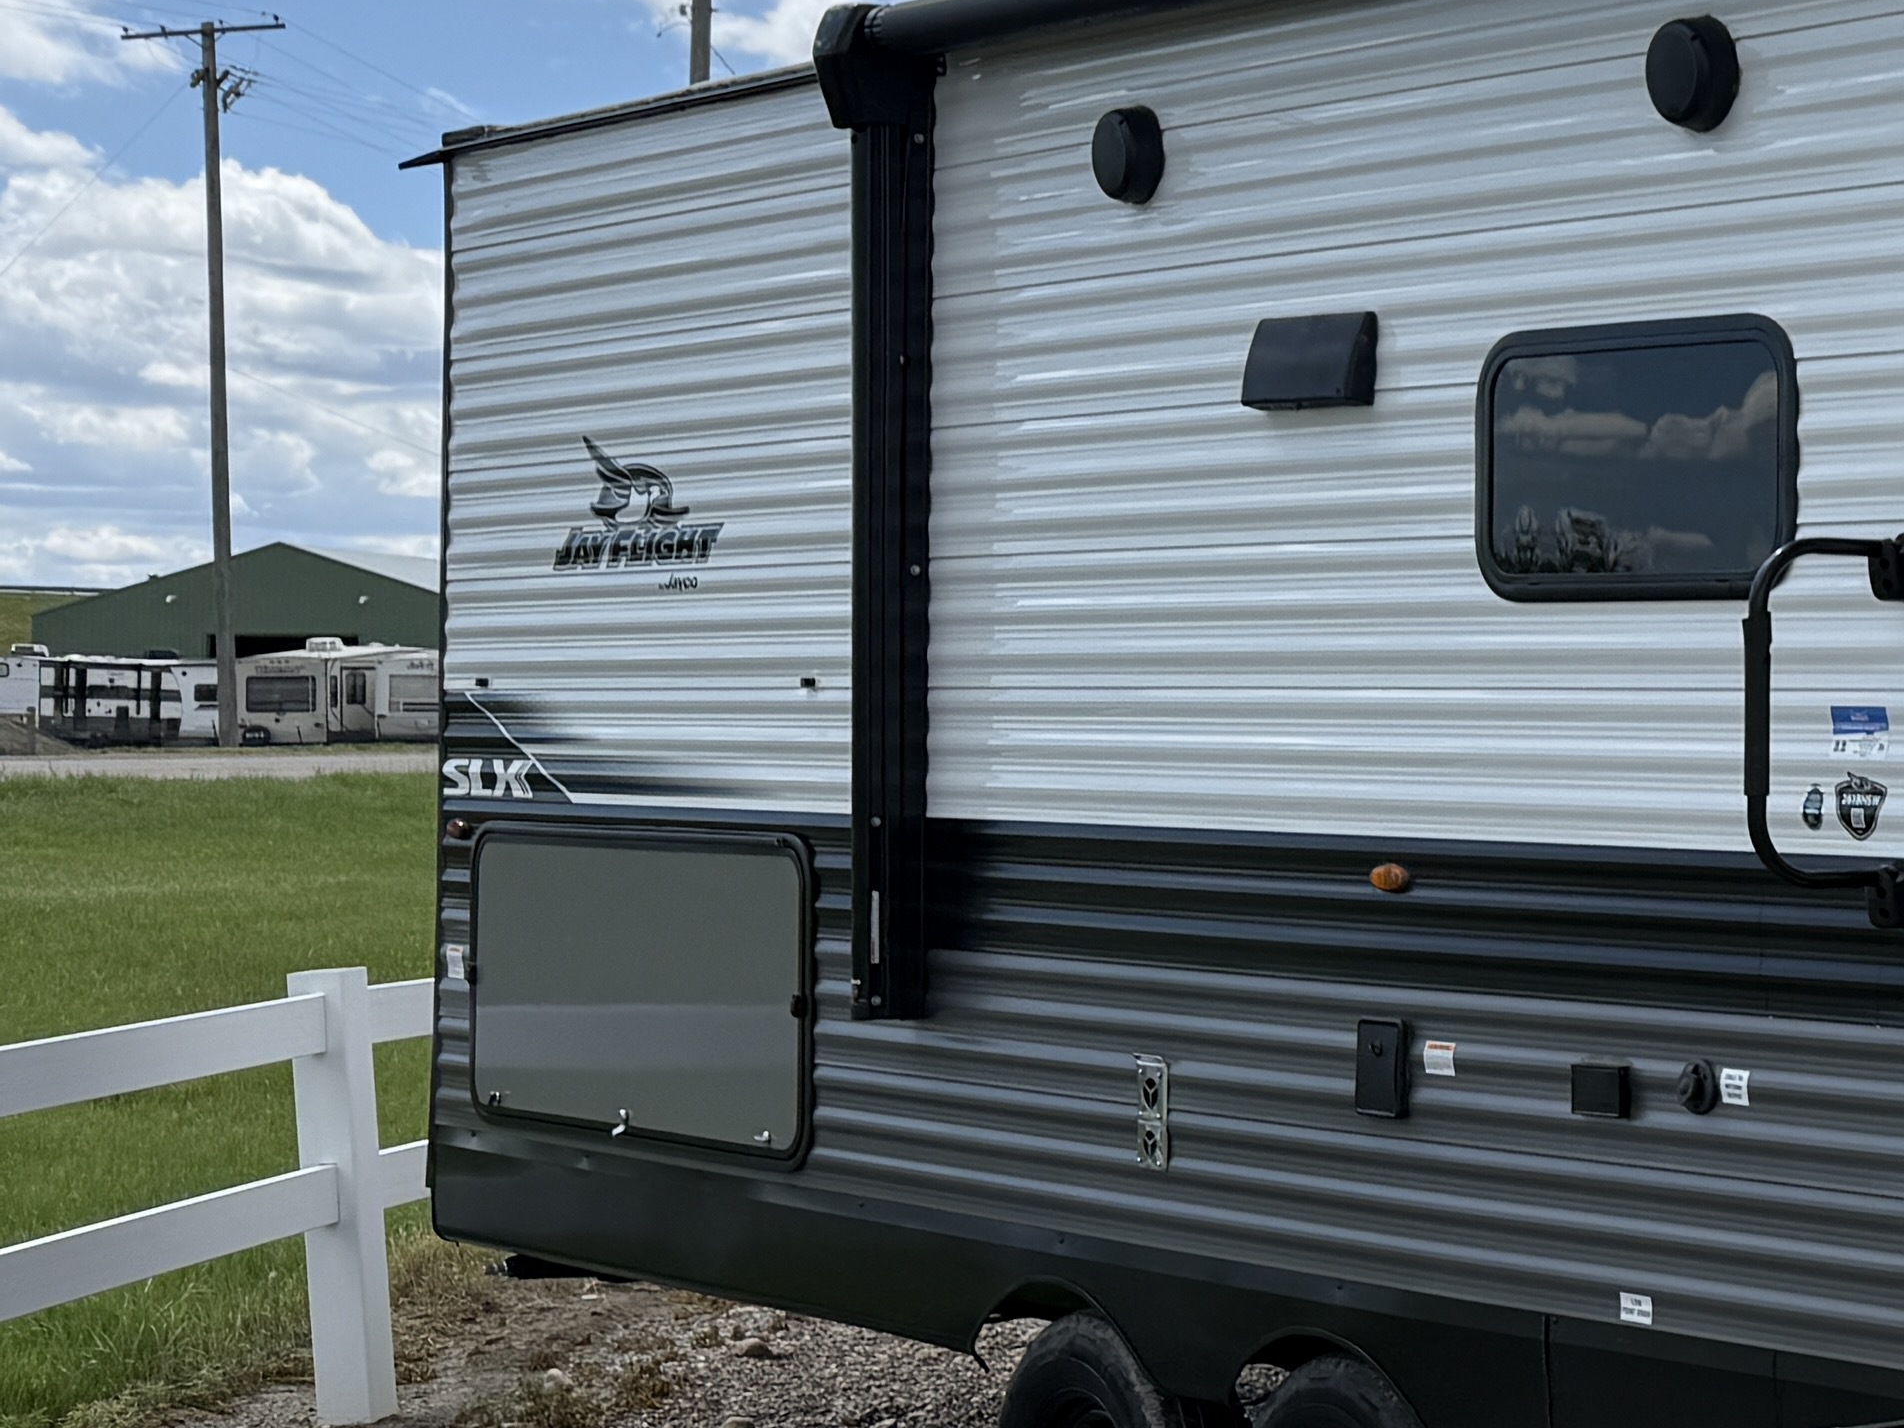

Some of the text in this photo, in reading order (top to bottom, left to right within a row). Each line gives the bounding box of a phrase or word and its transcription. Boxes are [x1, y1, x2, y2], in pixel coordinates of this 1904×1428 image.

[553, 522, 725, 571] JAY FLIGHT
[442, 758, 534, 798] SLX
